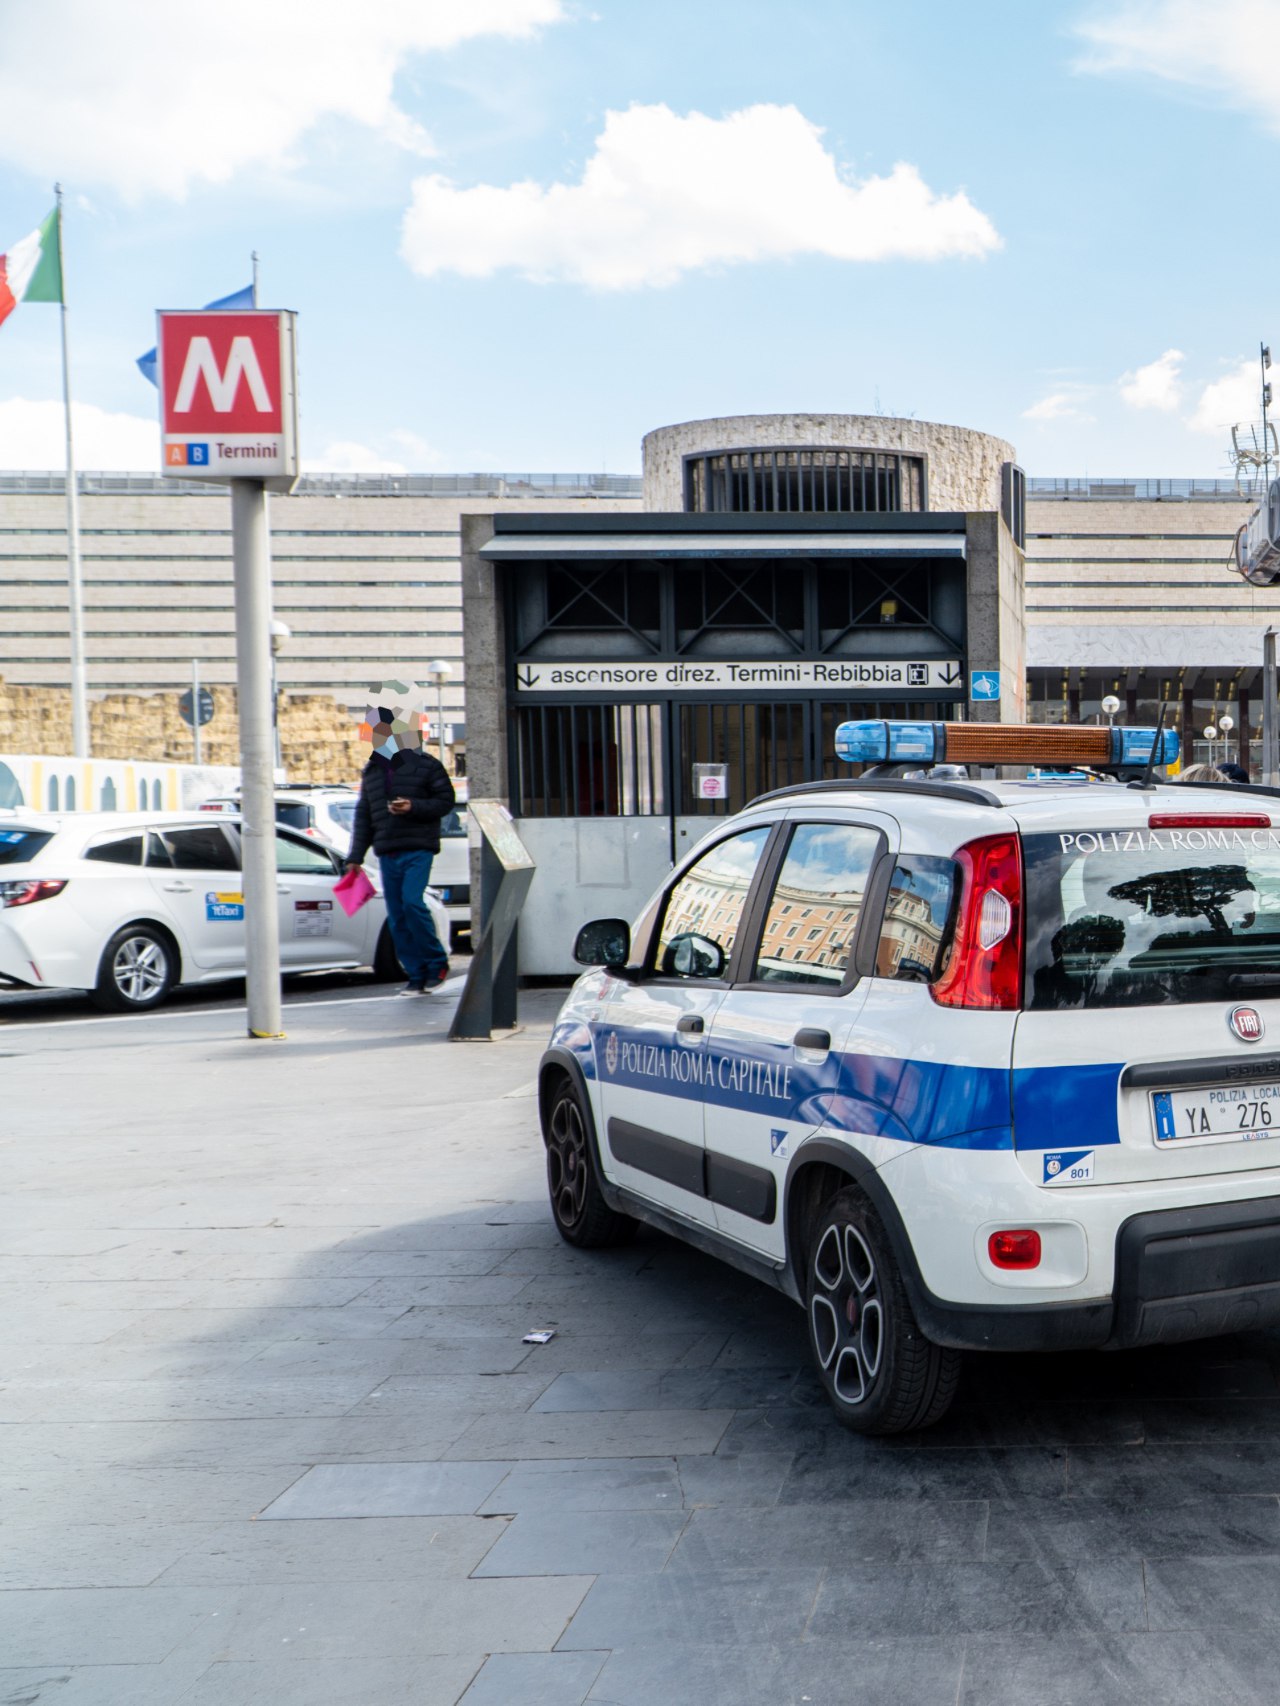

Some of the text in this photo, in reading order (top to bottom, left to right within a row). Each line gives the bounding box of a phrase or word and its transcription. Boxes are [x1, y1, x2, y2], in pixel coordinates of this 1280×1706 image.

[173, 336, 274, 413] M
[171, 443, 278, 462] A B Termini
[666, 664, 721, 682] direz.
[1059, 831, 1164, 854] POLIZIA
[1170, 831, 1247, 850] ROMA
[1238, 1015, 1258, 1032] FIAT
[622, 1042, 792, 1100] POLIZIA ROMA CAPITALE
[1210, 1089, 1248, 1103] POLIZIA
[1186, 1107, 1211, 1134] YA
[1237, 1101, 1272, 1129] 276
[1242, 1131, 1269, 1141] LEASYS
[1070, 1168, 1089, 1179] 801
